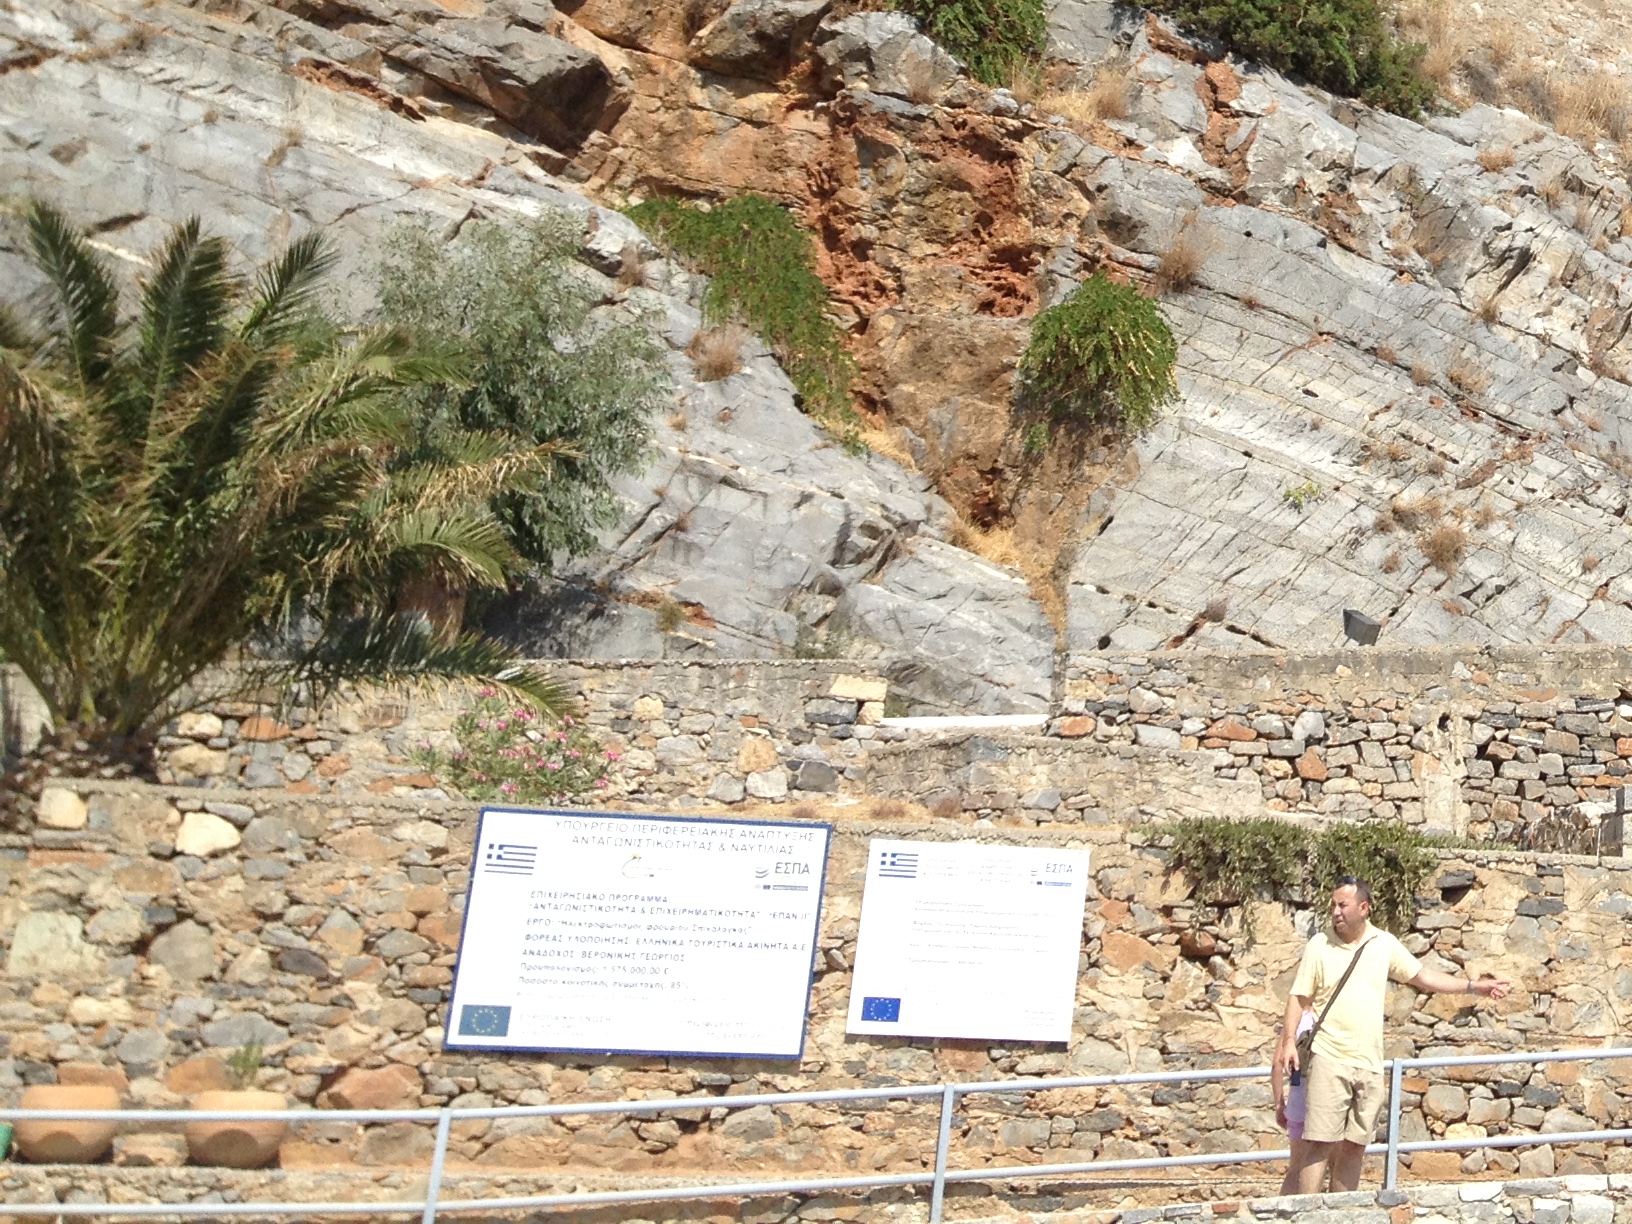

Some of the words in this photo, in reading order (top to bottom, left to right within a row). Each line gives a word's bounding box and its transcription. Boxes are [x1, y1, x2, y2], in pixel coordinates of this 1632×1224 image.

[555, 820, 628, 832] ΥΠΟΥΡΓΕΙΟ
[632, 823, 735, 838] ΠΕΡΙΦΕΡΕΙΑΚΗΣ
[739, 829, 815, 842] ΑΝΑΠΤΥΞΗΣ
[571, 835, 713, 851] ΑΝΤΑΓΩΝΙΣΤΙΚΟΤΗΤΑΣ
[718, 843, 726, 852] &
[730, 843, 795, 855] ΝΑΥΤΙΛΙΑΣ
[774, 861, 811, 875] ΕΣΠΑ
[1045, 862, 1073, 874] ΕΣΠΑ
[530, 890, 605, 901] ΕΠΙΧΕΙΡΗΣΙΑΚΟ
[640, 906, 646, 915] &
[524, 933, 563, 943] ΦΟΡΕΑΣ
[689, 939, 744, 949] ΤΟΥΡΙΣΤΙΚΑ
[747, 941, 789, 951] ΑΚΙΝΗΤΑ
